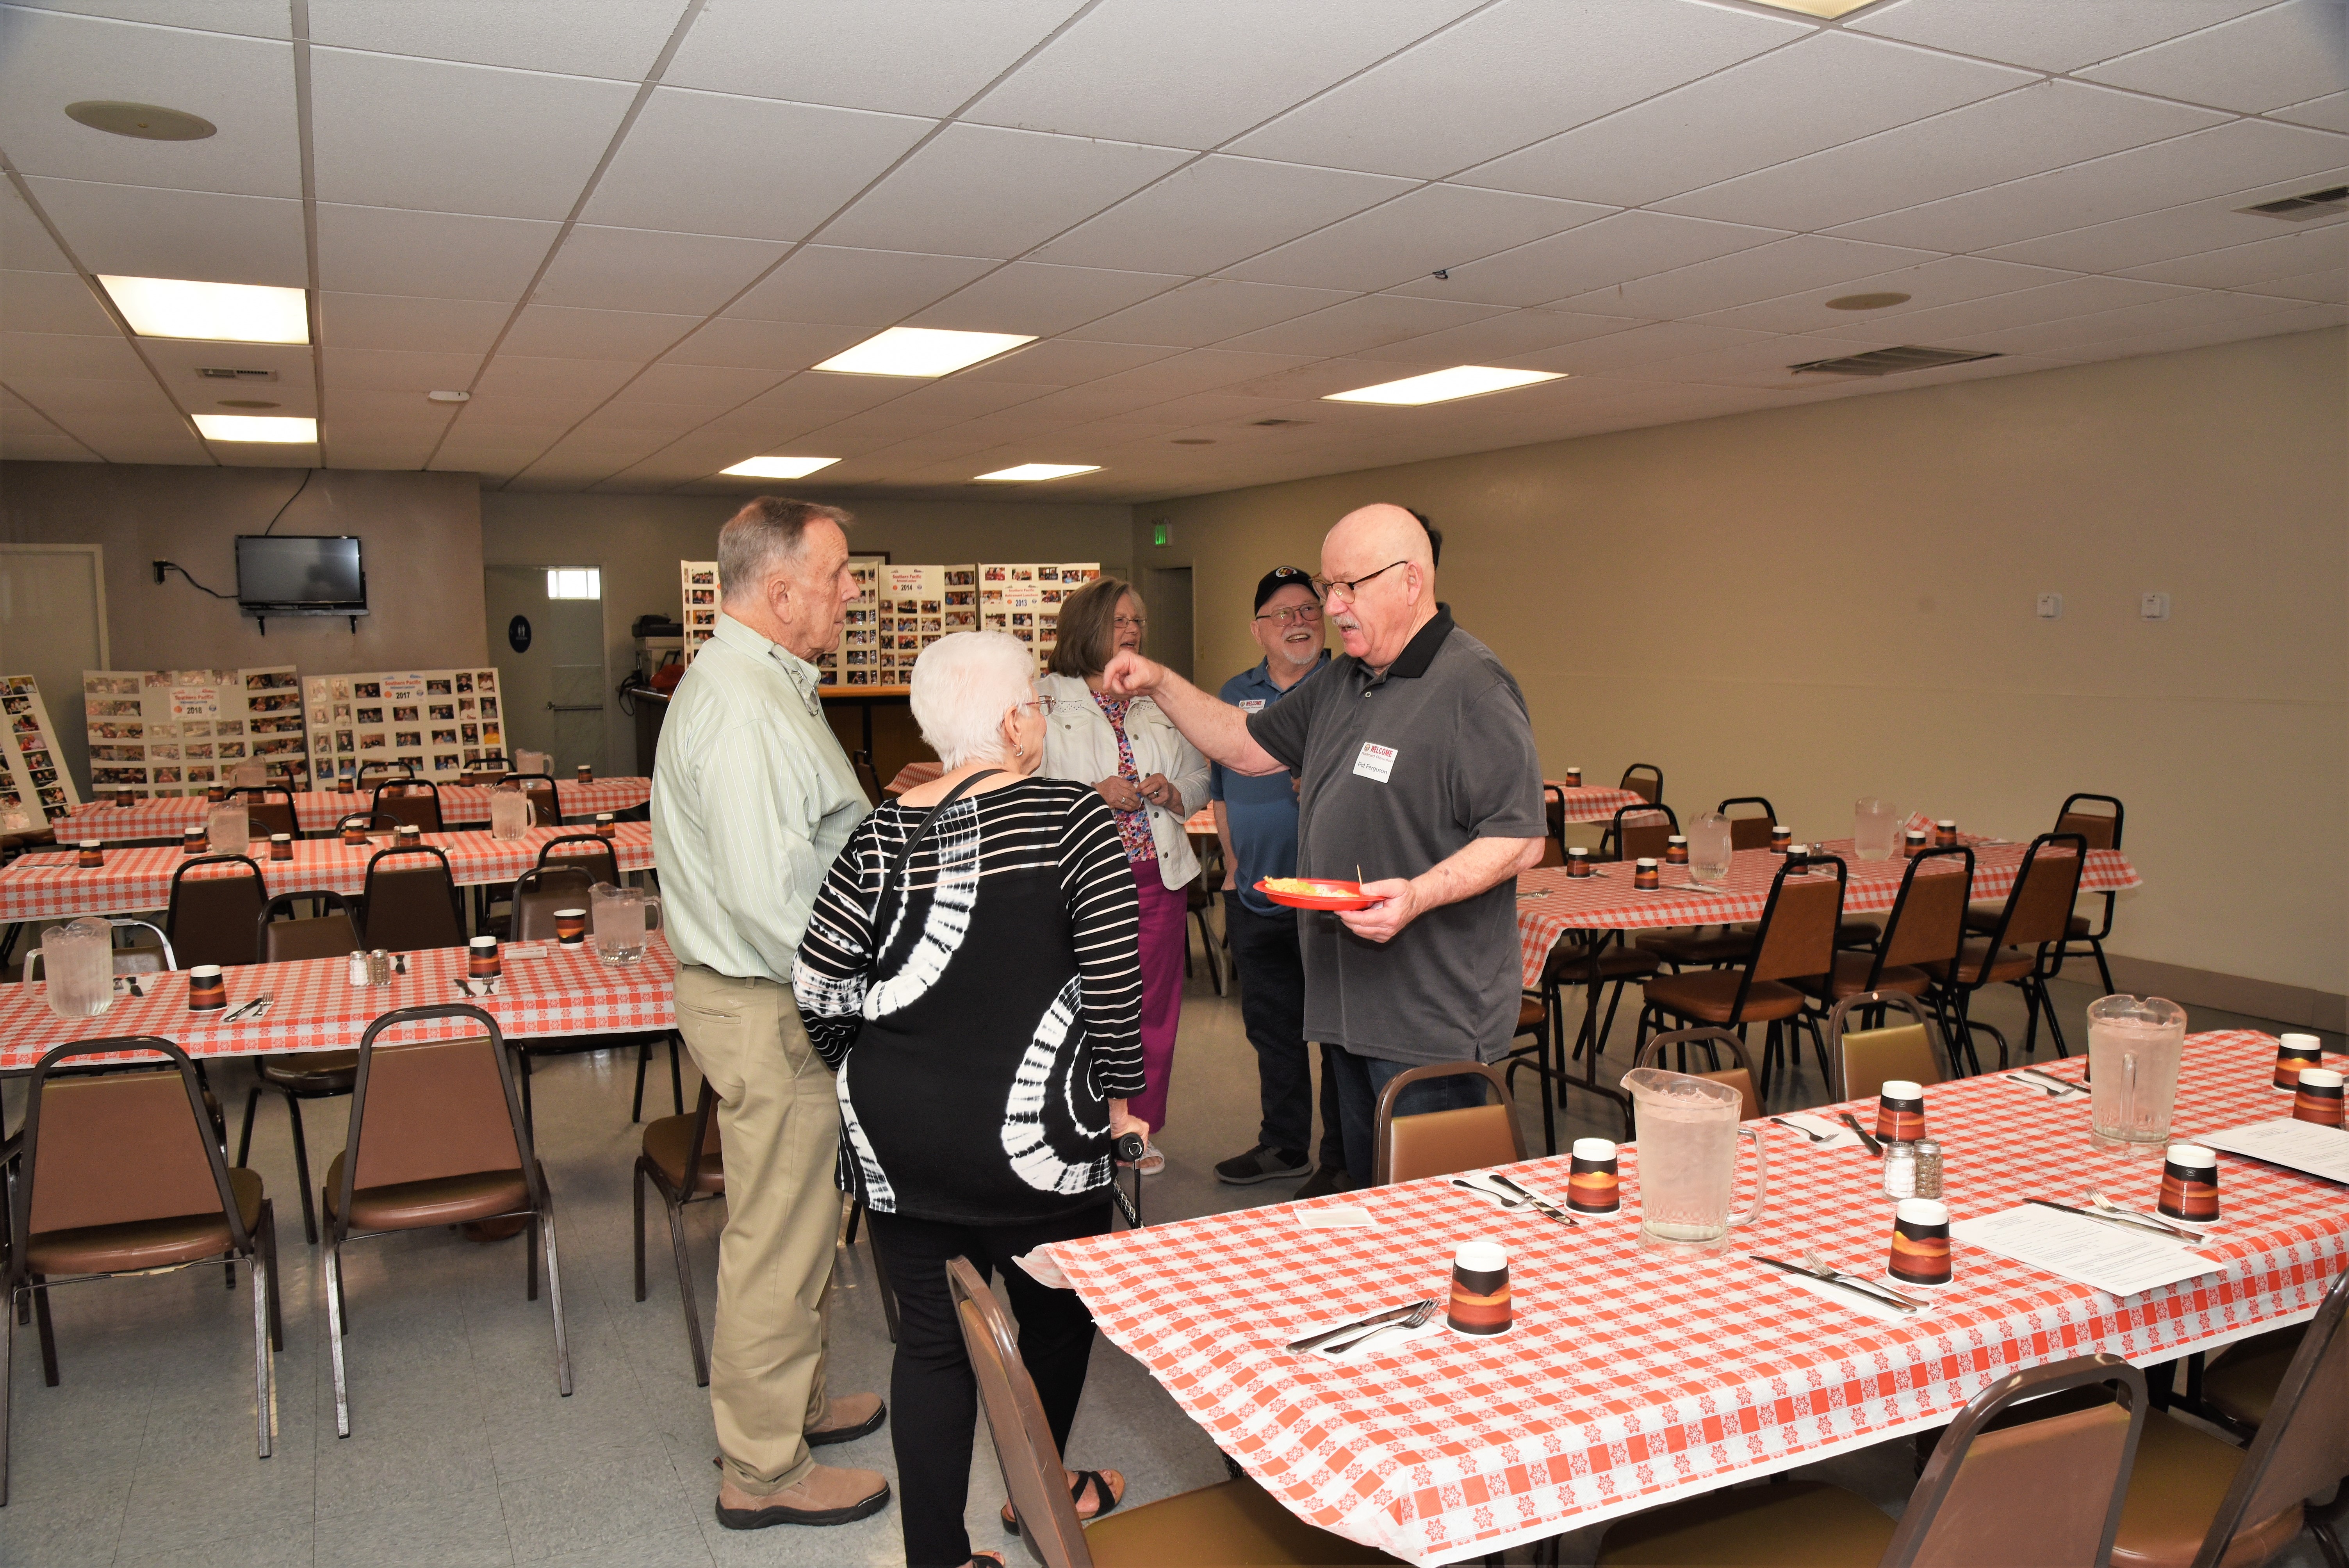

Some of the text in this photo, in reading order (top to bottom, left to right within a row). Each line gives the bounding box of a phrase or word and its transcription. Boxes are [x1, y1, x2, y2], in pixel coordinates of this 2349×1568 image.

[1370, 745, 1393, 757] WELCOME
[1376, 755, 1393, 763] Reunion
[1365, 763, 1387, 775] Ferguson
